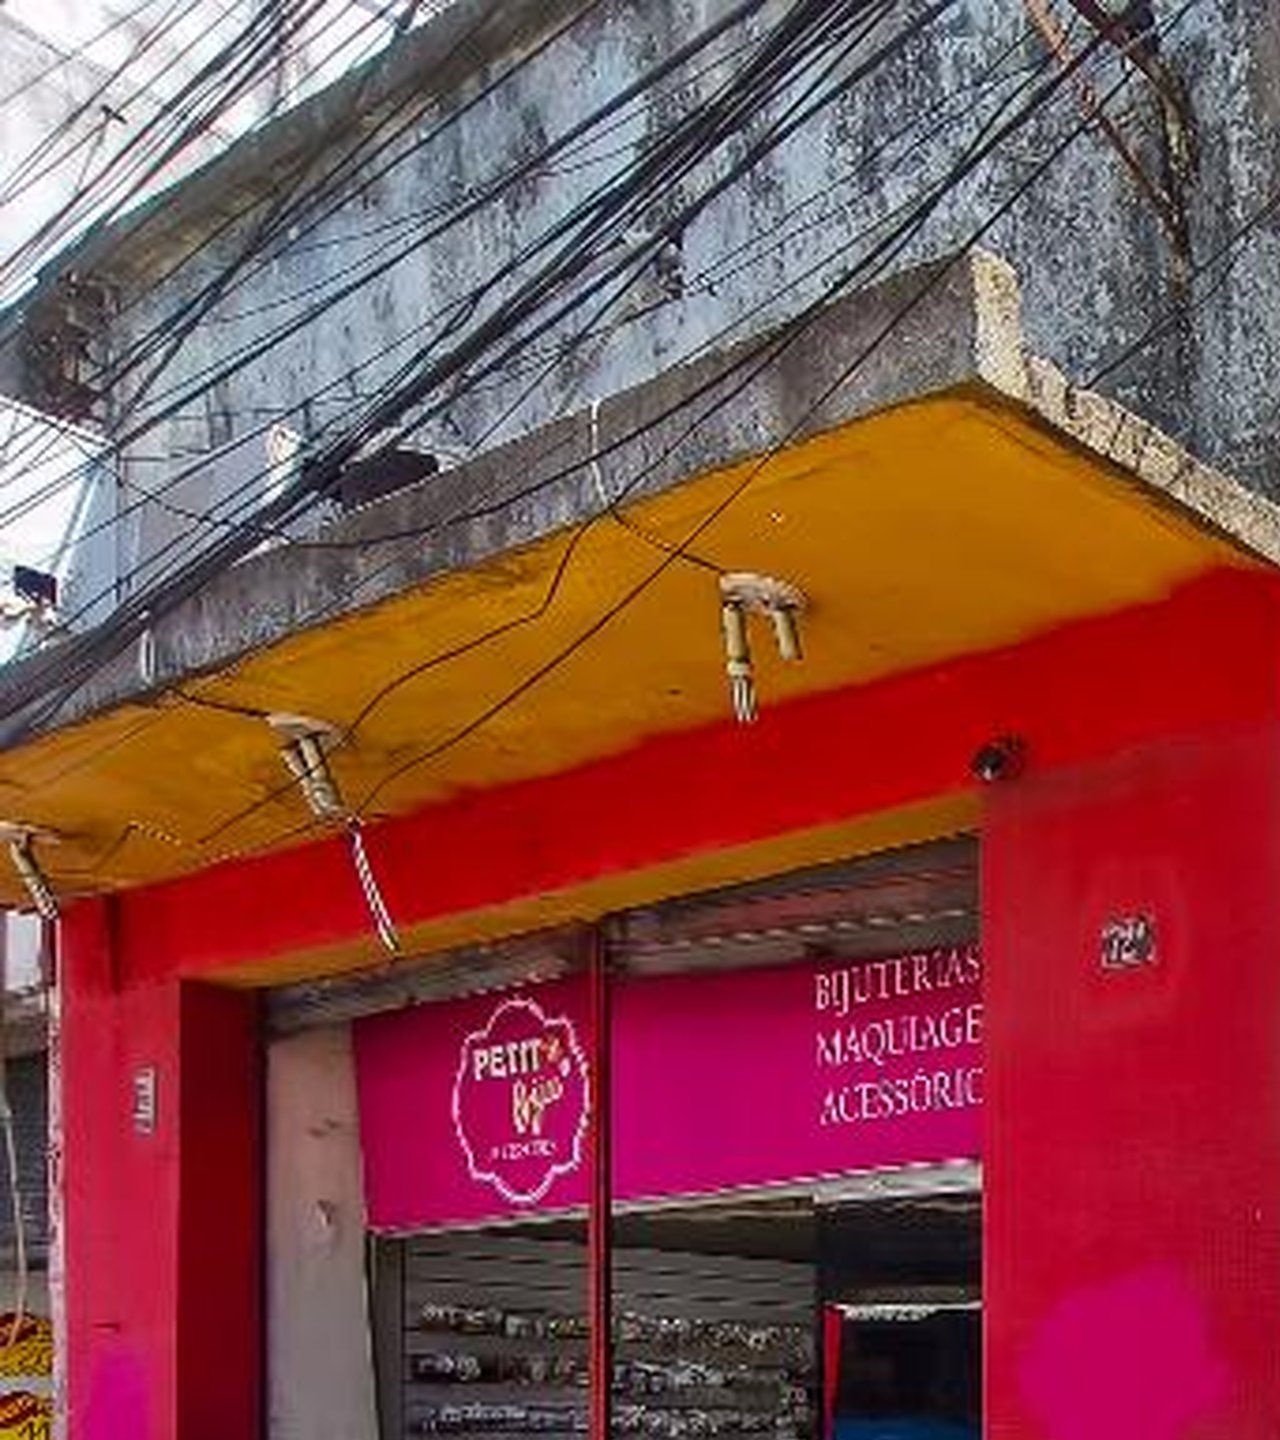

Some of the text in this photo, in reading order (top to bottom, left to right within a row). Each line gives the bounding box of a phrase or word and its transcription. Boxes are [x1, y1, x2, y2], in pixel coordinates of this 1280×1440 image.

[814, 946, 981, 1017] BIJUTERIAS
[472, 1038, 542, 1081] PETIT
[815, 1003, 984, 1067] MAQUIAGE
